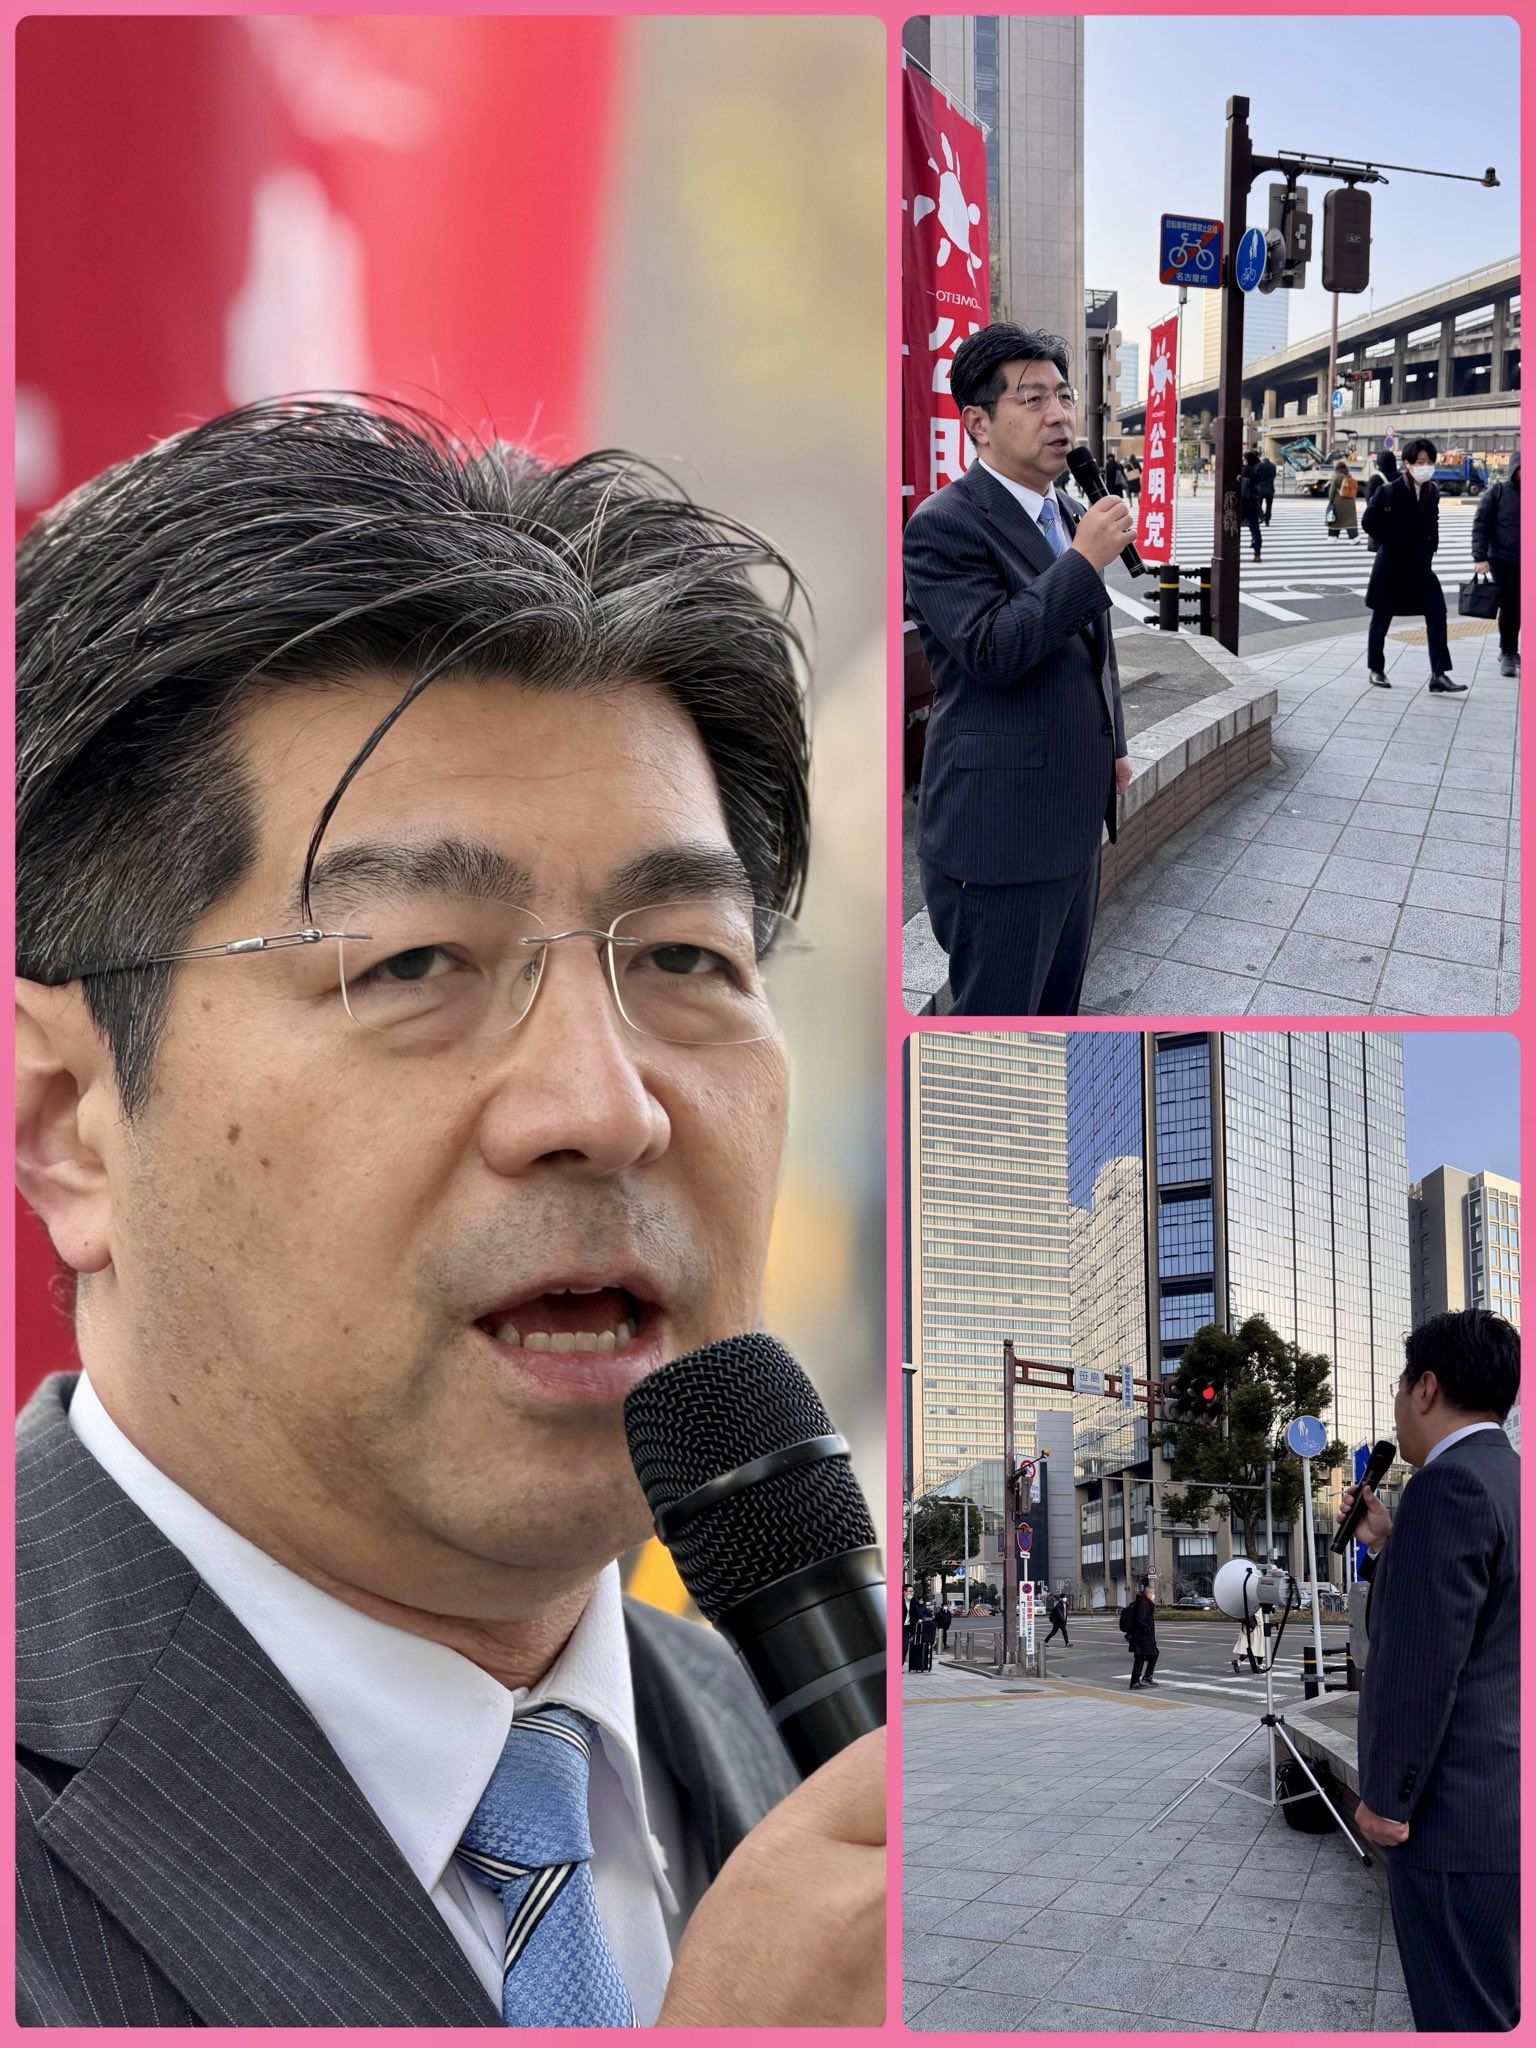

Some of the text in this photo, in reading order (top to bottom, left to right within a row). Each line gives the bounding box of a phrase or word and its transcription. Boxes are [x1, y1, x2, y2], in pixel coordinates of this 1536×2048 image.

[1176, 272, 1208, 283] 名古屋市
[1144, 422, 1166, 548] 公明党
[1079, 1370, 1100, 1383] 笹島
